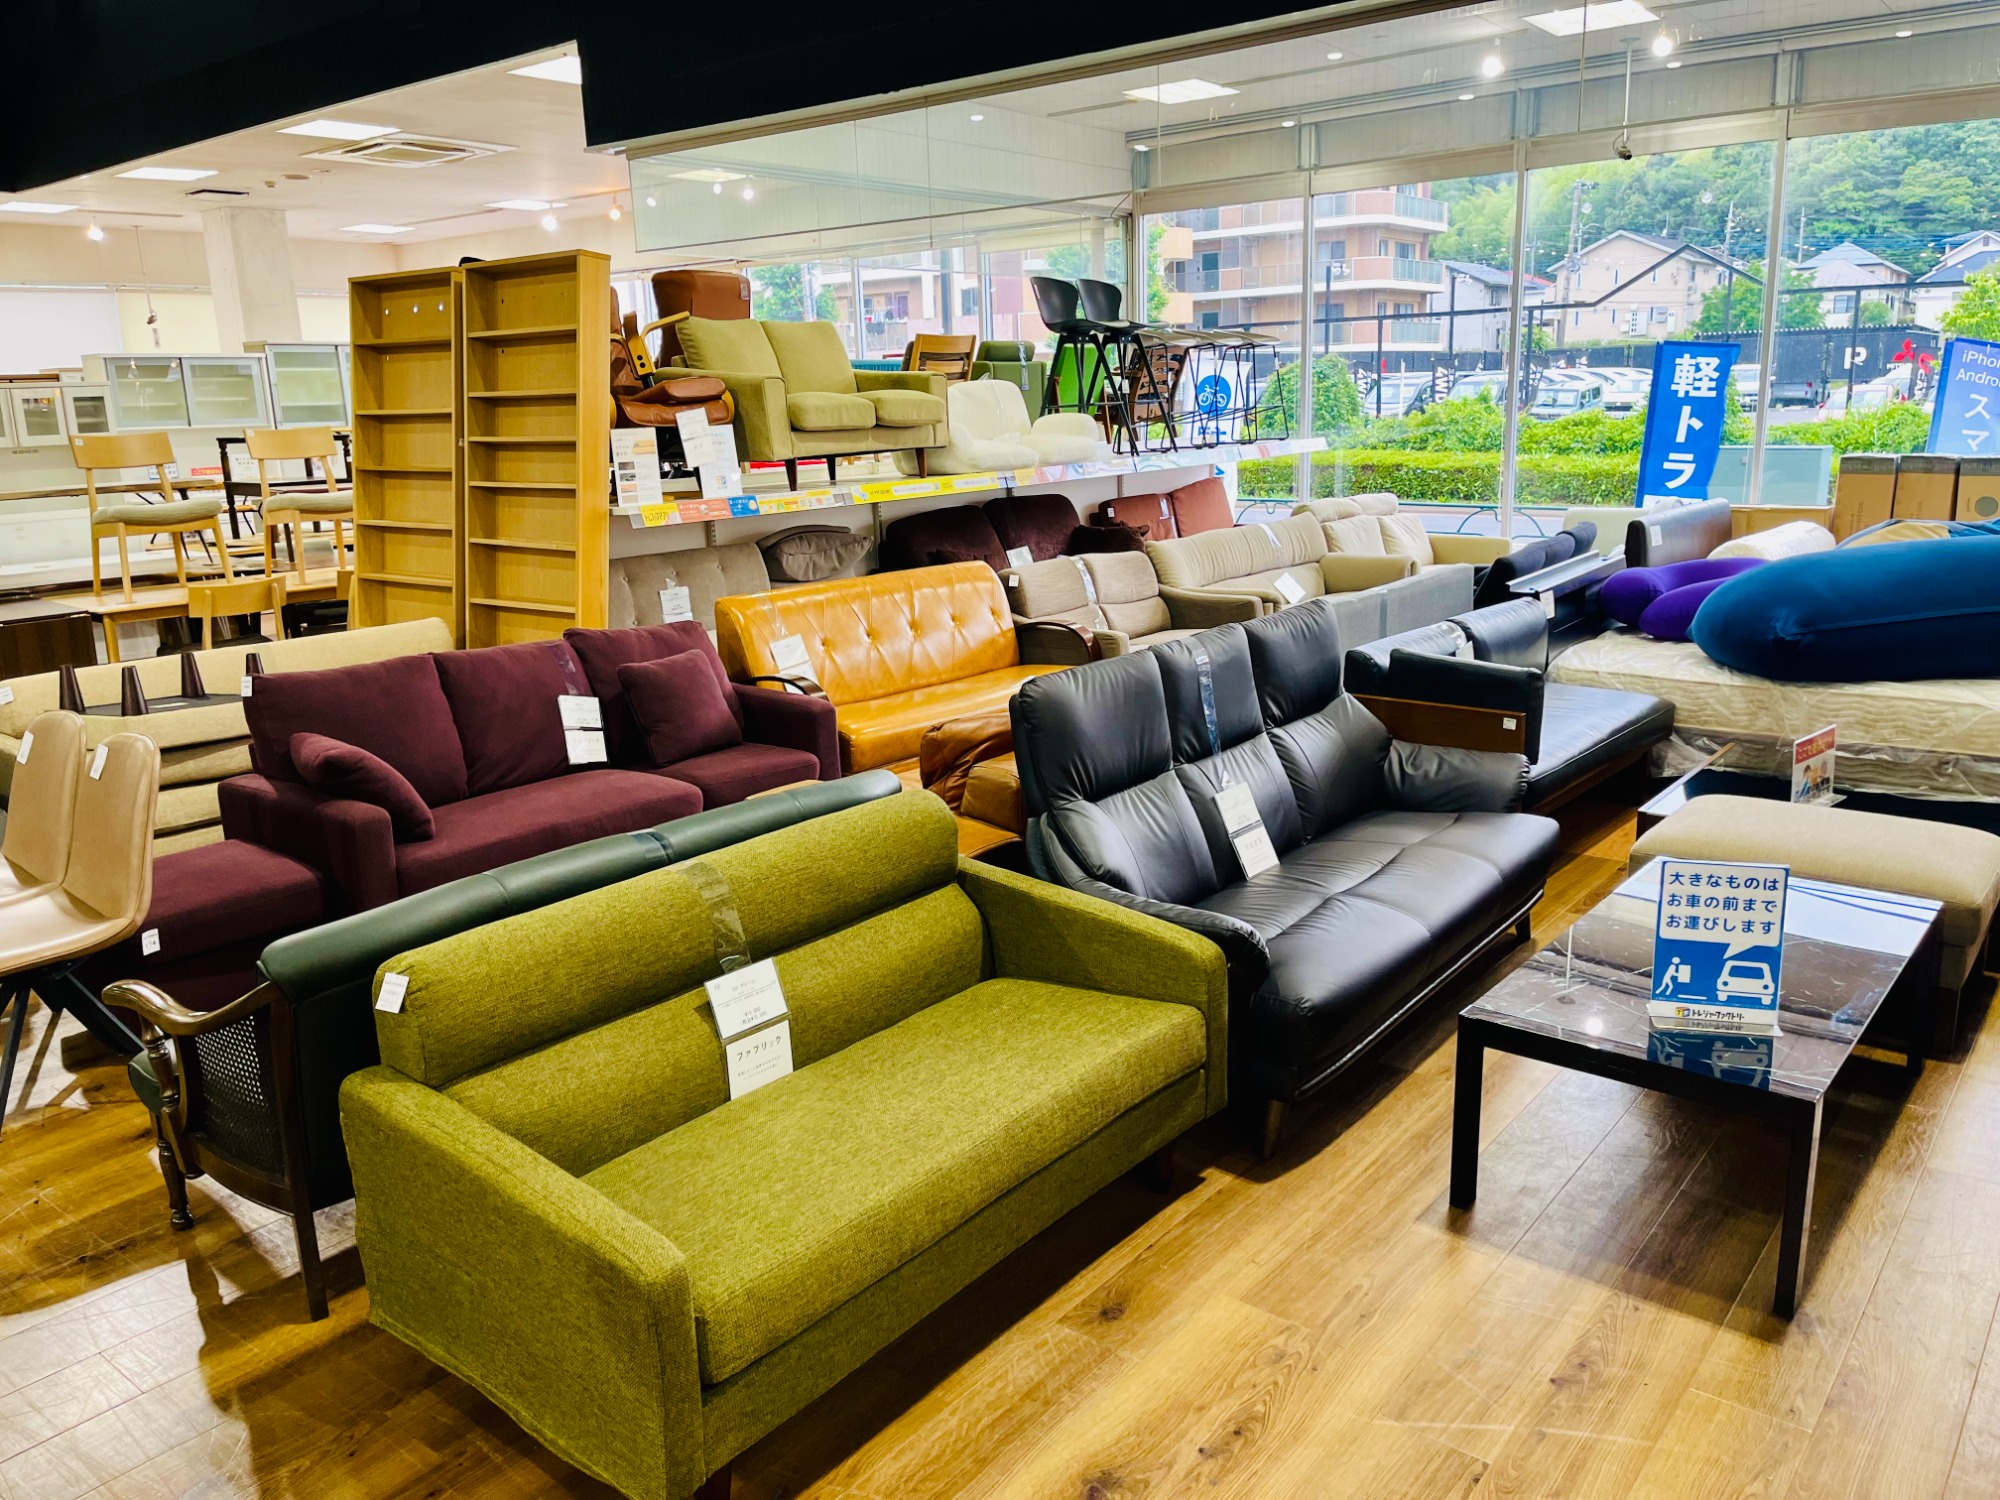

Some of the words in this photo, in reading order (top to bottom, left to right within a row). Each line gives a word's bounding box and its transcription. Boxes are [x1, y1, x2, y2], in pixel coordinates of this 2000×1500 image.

[1435, 366, 1448, 404] 4WD
[1662, 353, 1721, 489] 軽トラ
[1961, 393, 1991, 452] スマ
[1669, 872, 1779, 891] 大きなものは
[1667, 893, 1778, 913] お車の前まで
[1666, 914, 1776, 935] お運びします
[1692, 1009, 1745, 1021] トレジャーファクトリー
[737, 1035, 782, 1062] ファブリック
